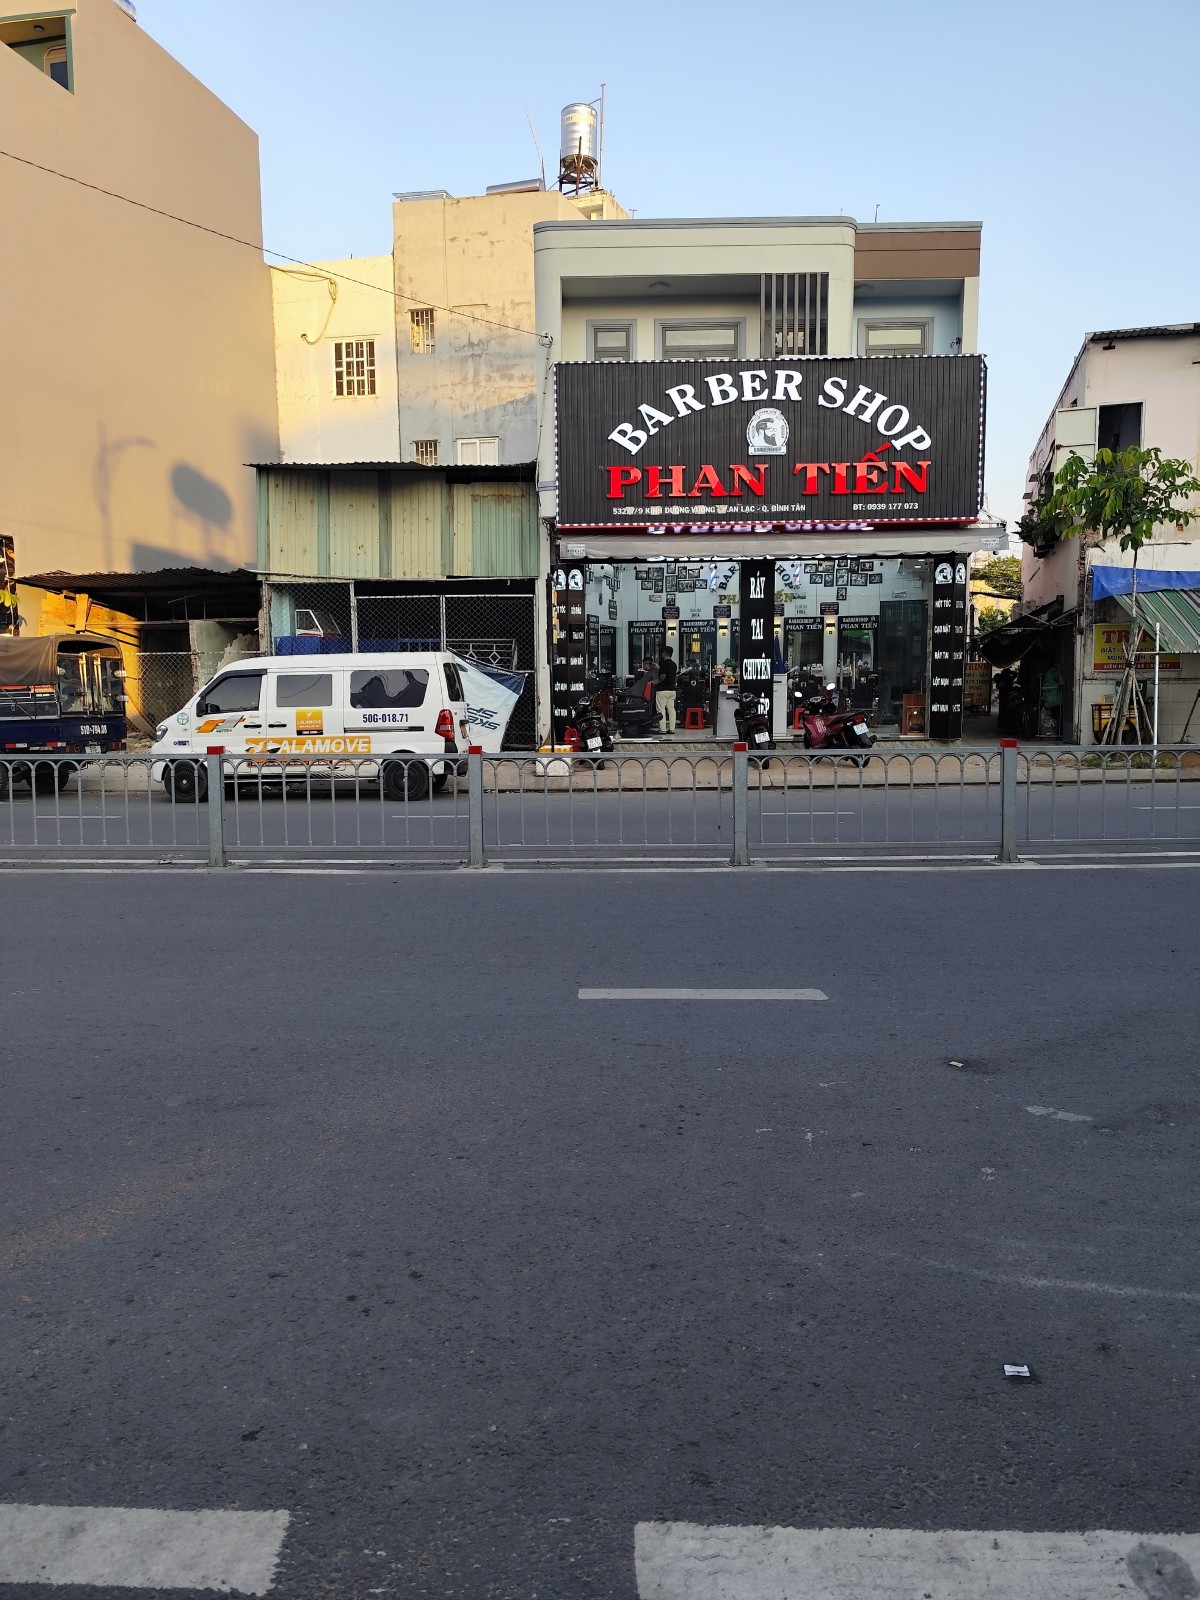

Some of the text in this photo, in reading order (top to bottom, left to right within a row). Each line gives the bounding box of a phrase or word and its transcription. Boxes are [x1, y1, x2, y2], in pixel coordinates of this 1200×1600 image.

[608, 369, 932, 455] BARBER SHOP
[606, 442, 932, 498] PHAN TIẾN
[888, 502, 903, 510] 177
[904, 502, 919, 510] 073
[749, 570, 766, 599] RÁY
[750, 618, 764, 640] TAI
[742, 652, 771, 680] CHUYÊN
[362, 713, 409, 724] 50G-018.71
[268, 738, 370, 755] ALAMOVE
